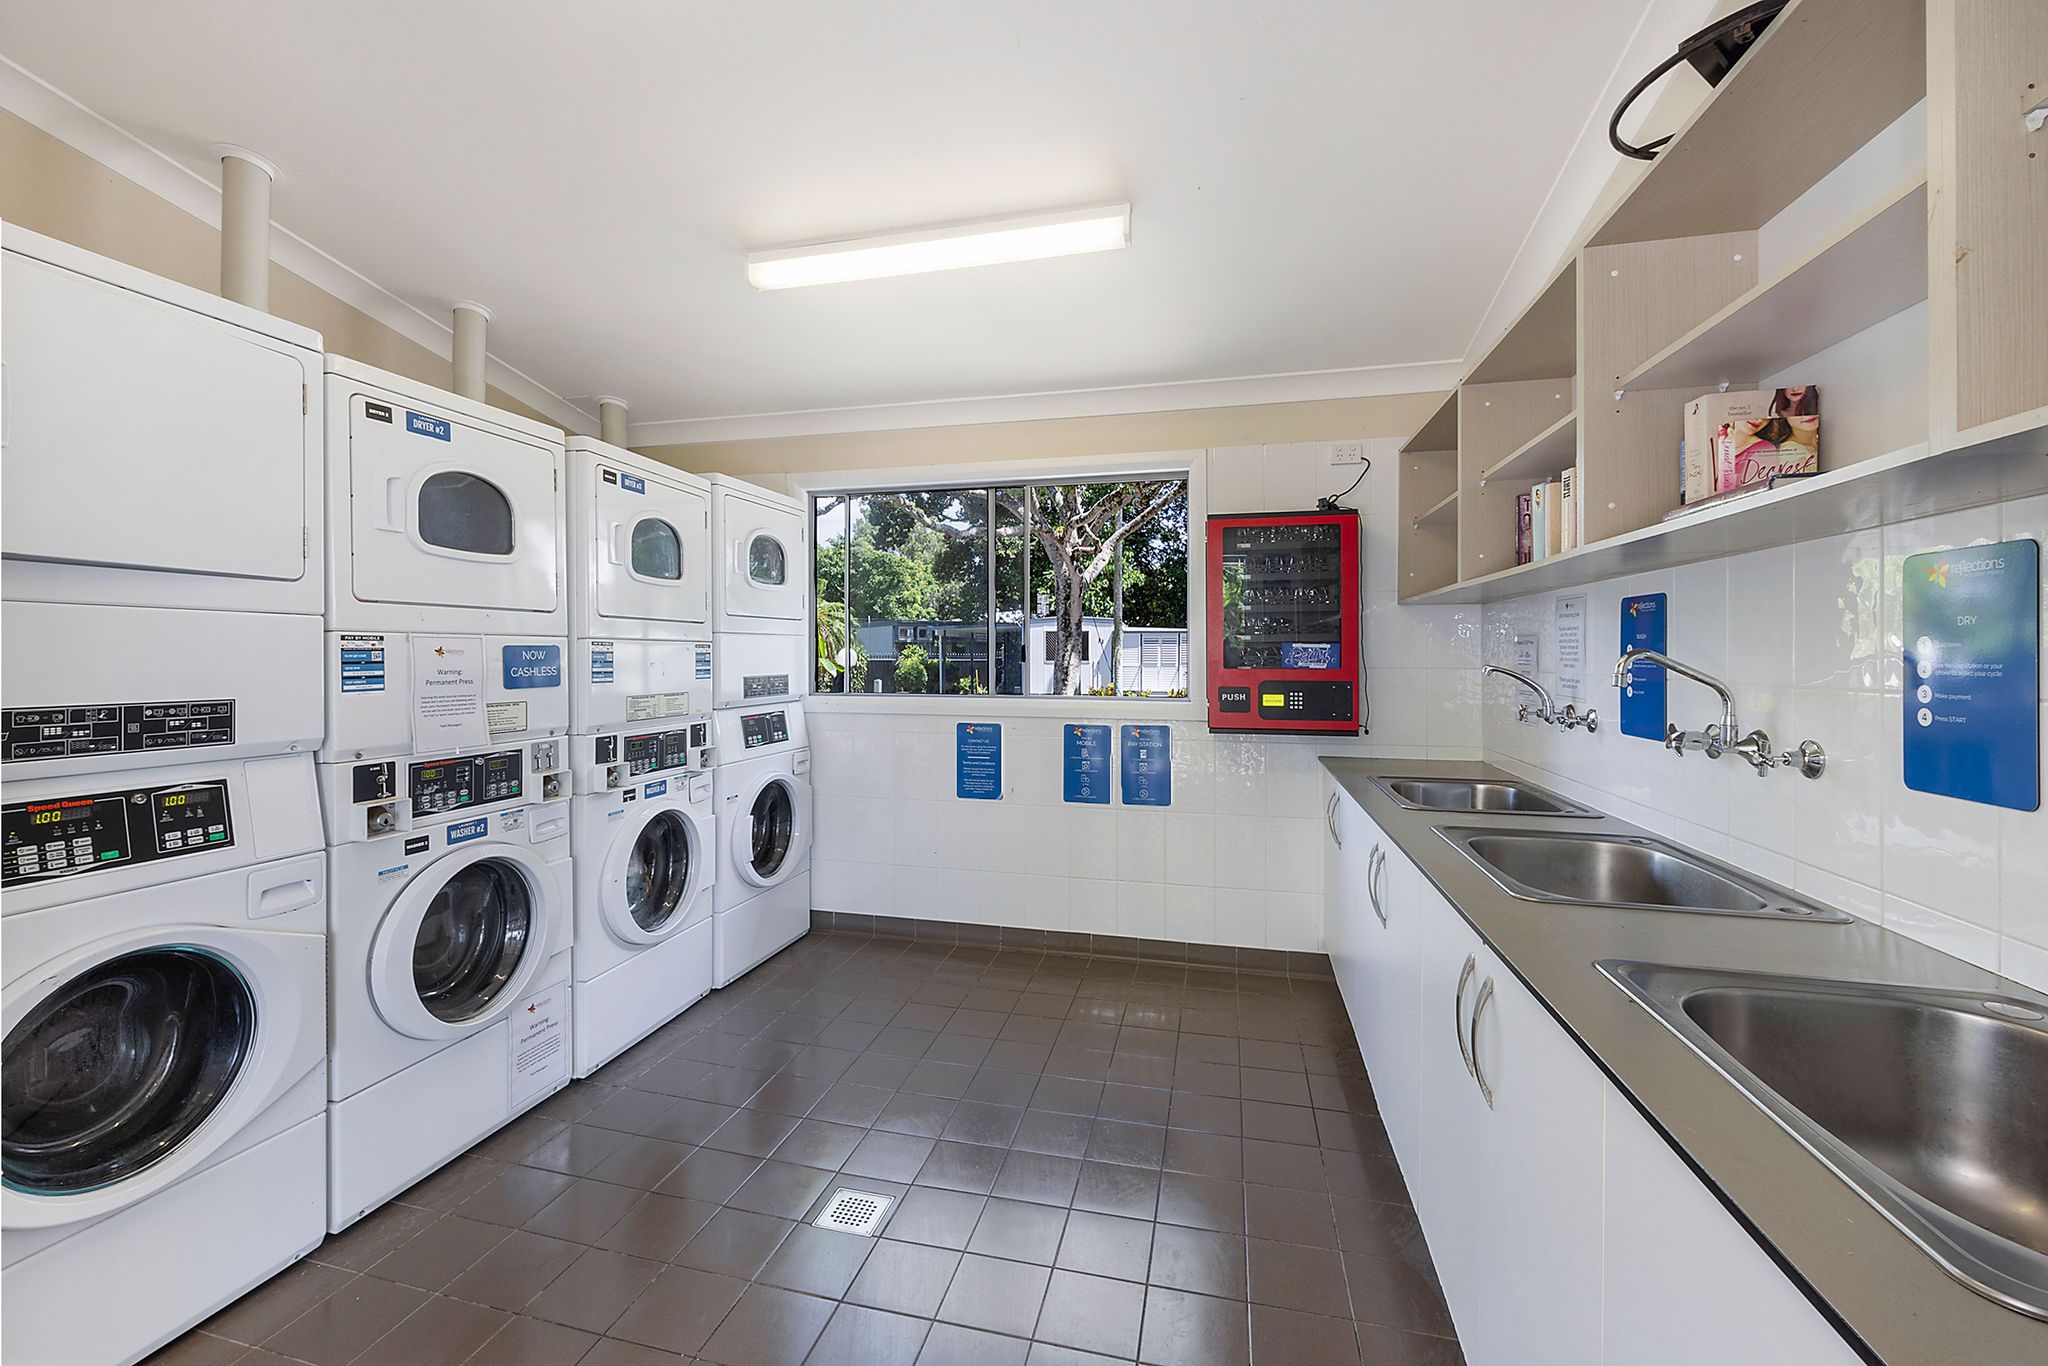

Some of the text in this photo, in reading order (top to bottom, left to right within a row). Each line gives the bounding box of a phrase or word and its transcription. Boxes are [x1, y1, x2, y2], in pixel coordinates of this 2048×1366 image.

[413, 418, 434, 433] DRYER
[1740, 454, 1815, 485] Dearest
[1951, 557, 2005, 577] reflections
[1957, 615, 1978, 626] DRY
[522, 650, 546, 660] NOW
[510, 666, 558, 678] CASHLESS
[1922, 665, 1928, 674] 2
[1221, 693, 1246, 701] PUSH
[1922, 690, 1928, 699] 3
[1921, 713, 1928, 721] 4
[26, 799, 94, 813] Speed Queen
[450, 825, 476, 840] WASHER
